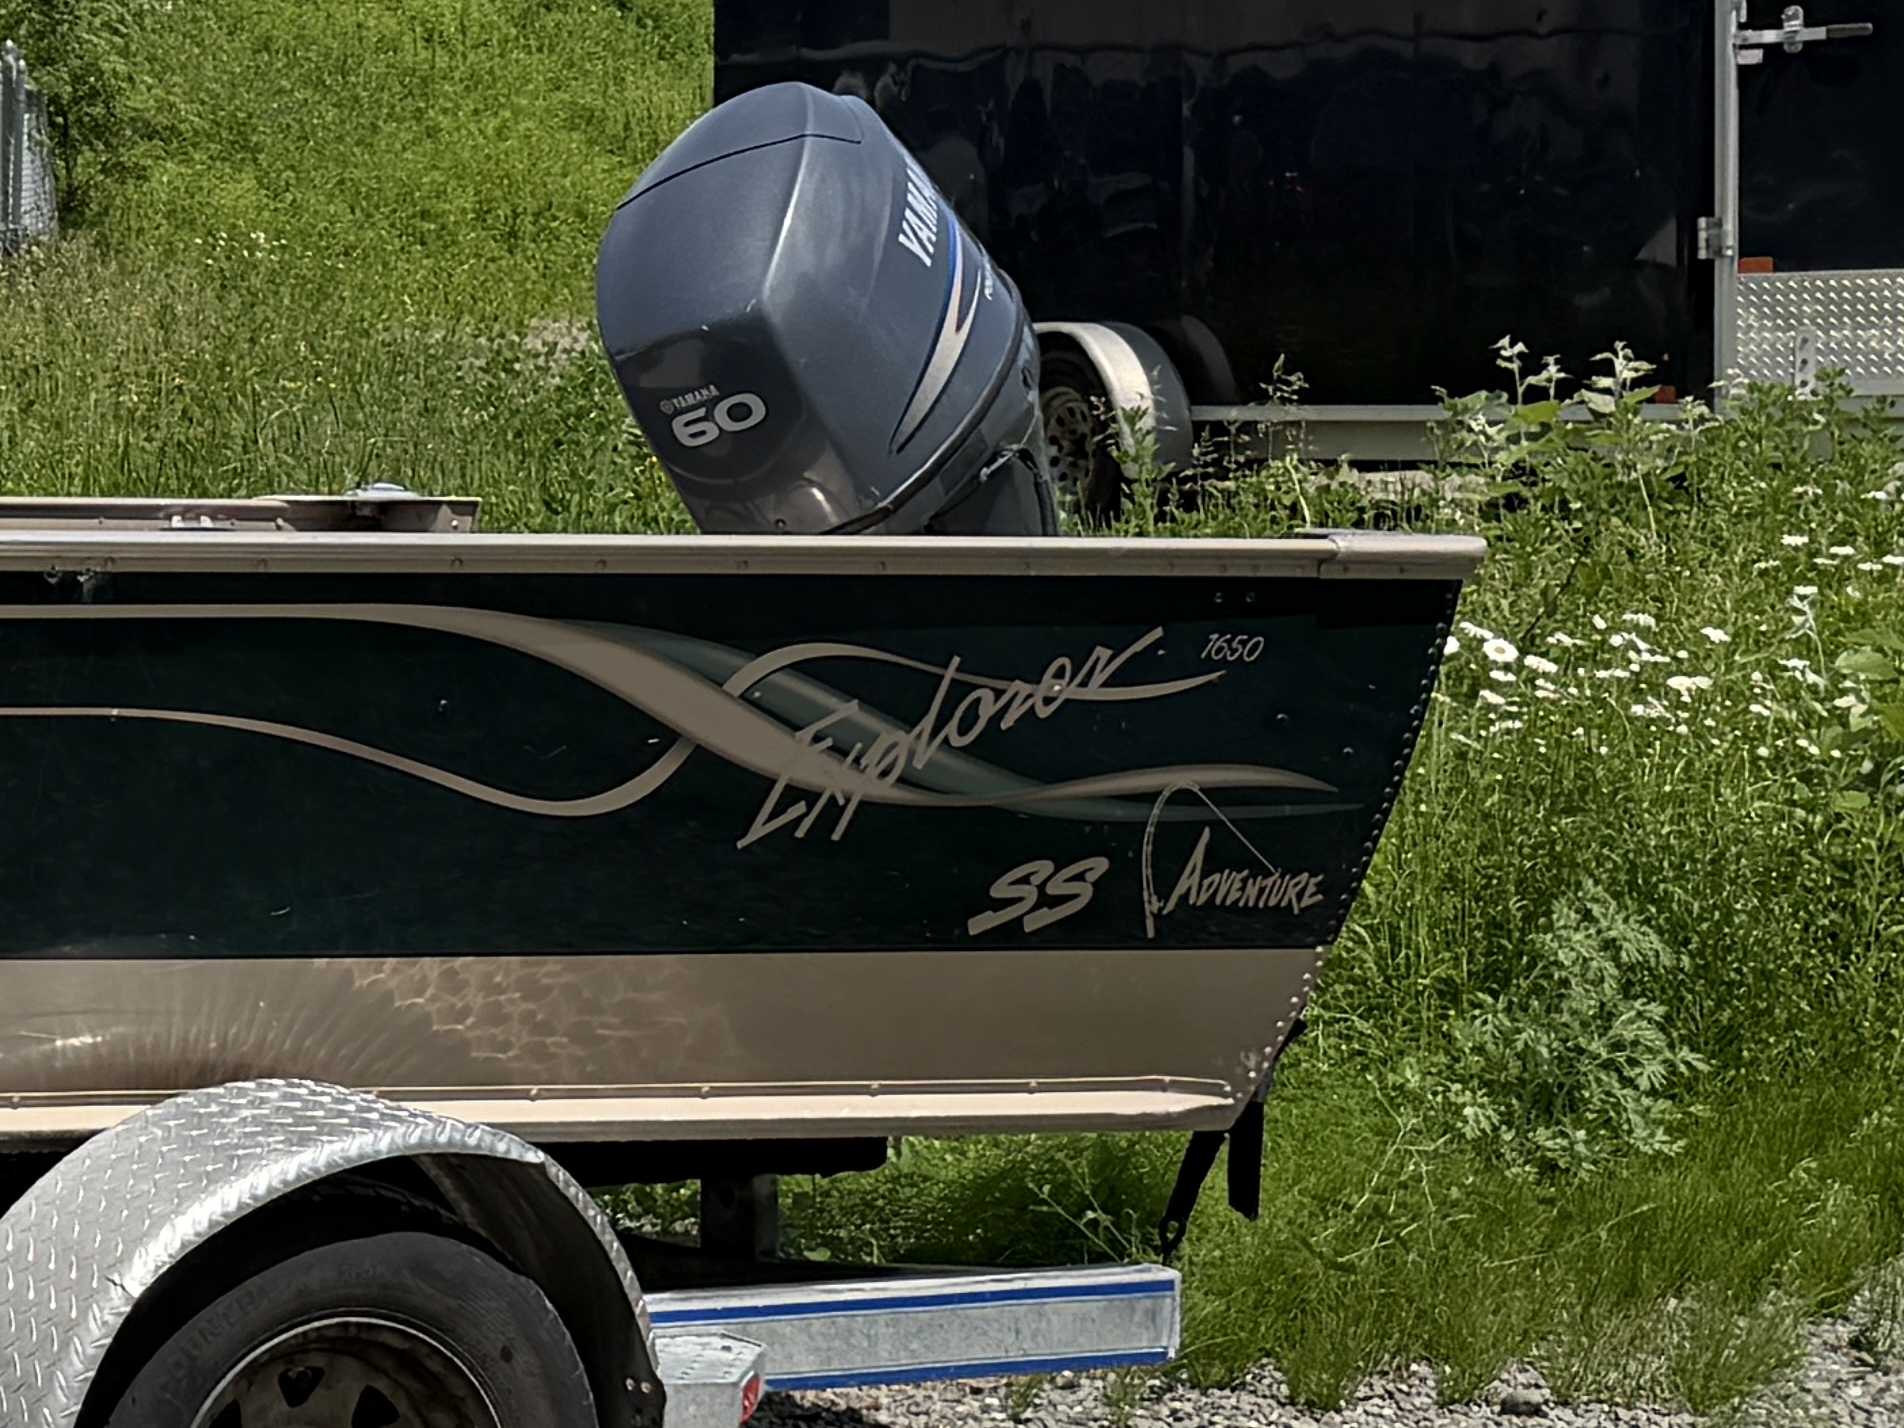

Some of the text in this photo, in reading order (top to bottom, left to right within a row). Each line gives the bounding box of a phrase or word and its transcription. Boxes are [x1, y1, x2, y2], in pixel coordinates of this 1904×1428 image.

[671, 392, 767, 448] 60
[1199, 632, 1265, 663] 1650
[737, 626, 1164, 849] Explorer
[967, 856, 1111, 936] SS
